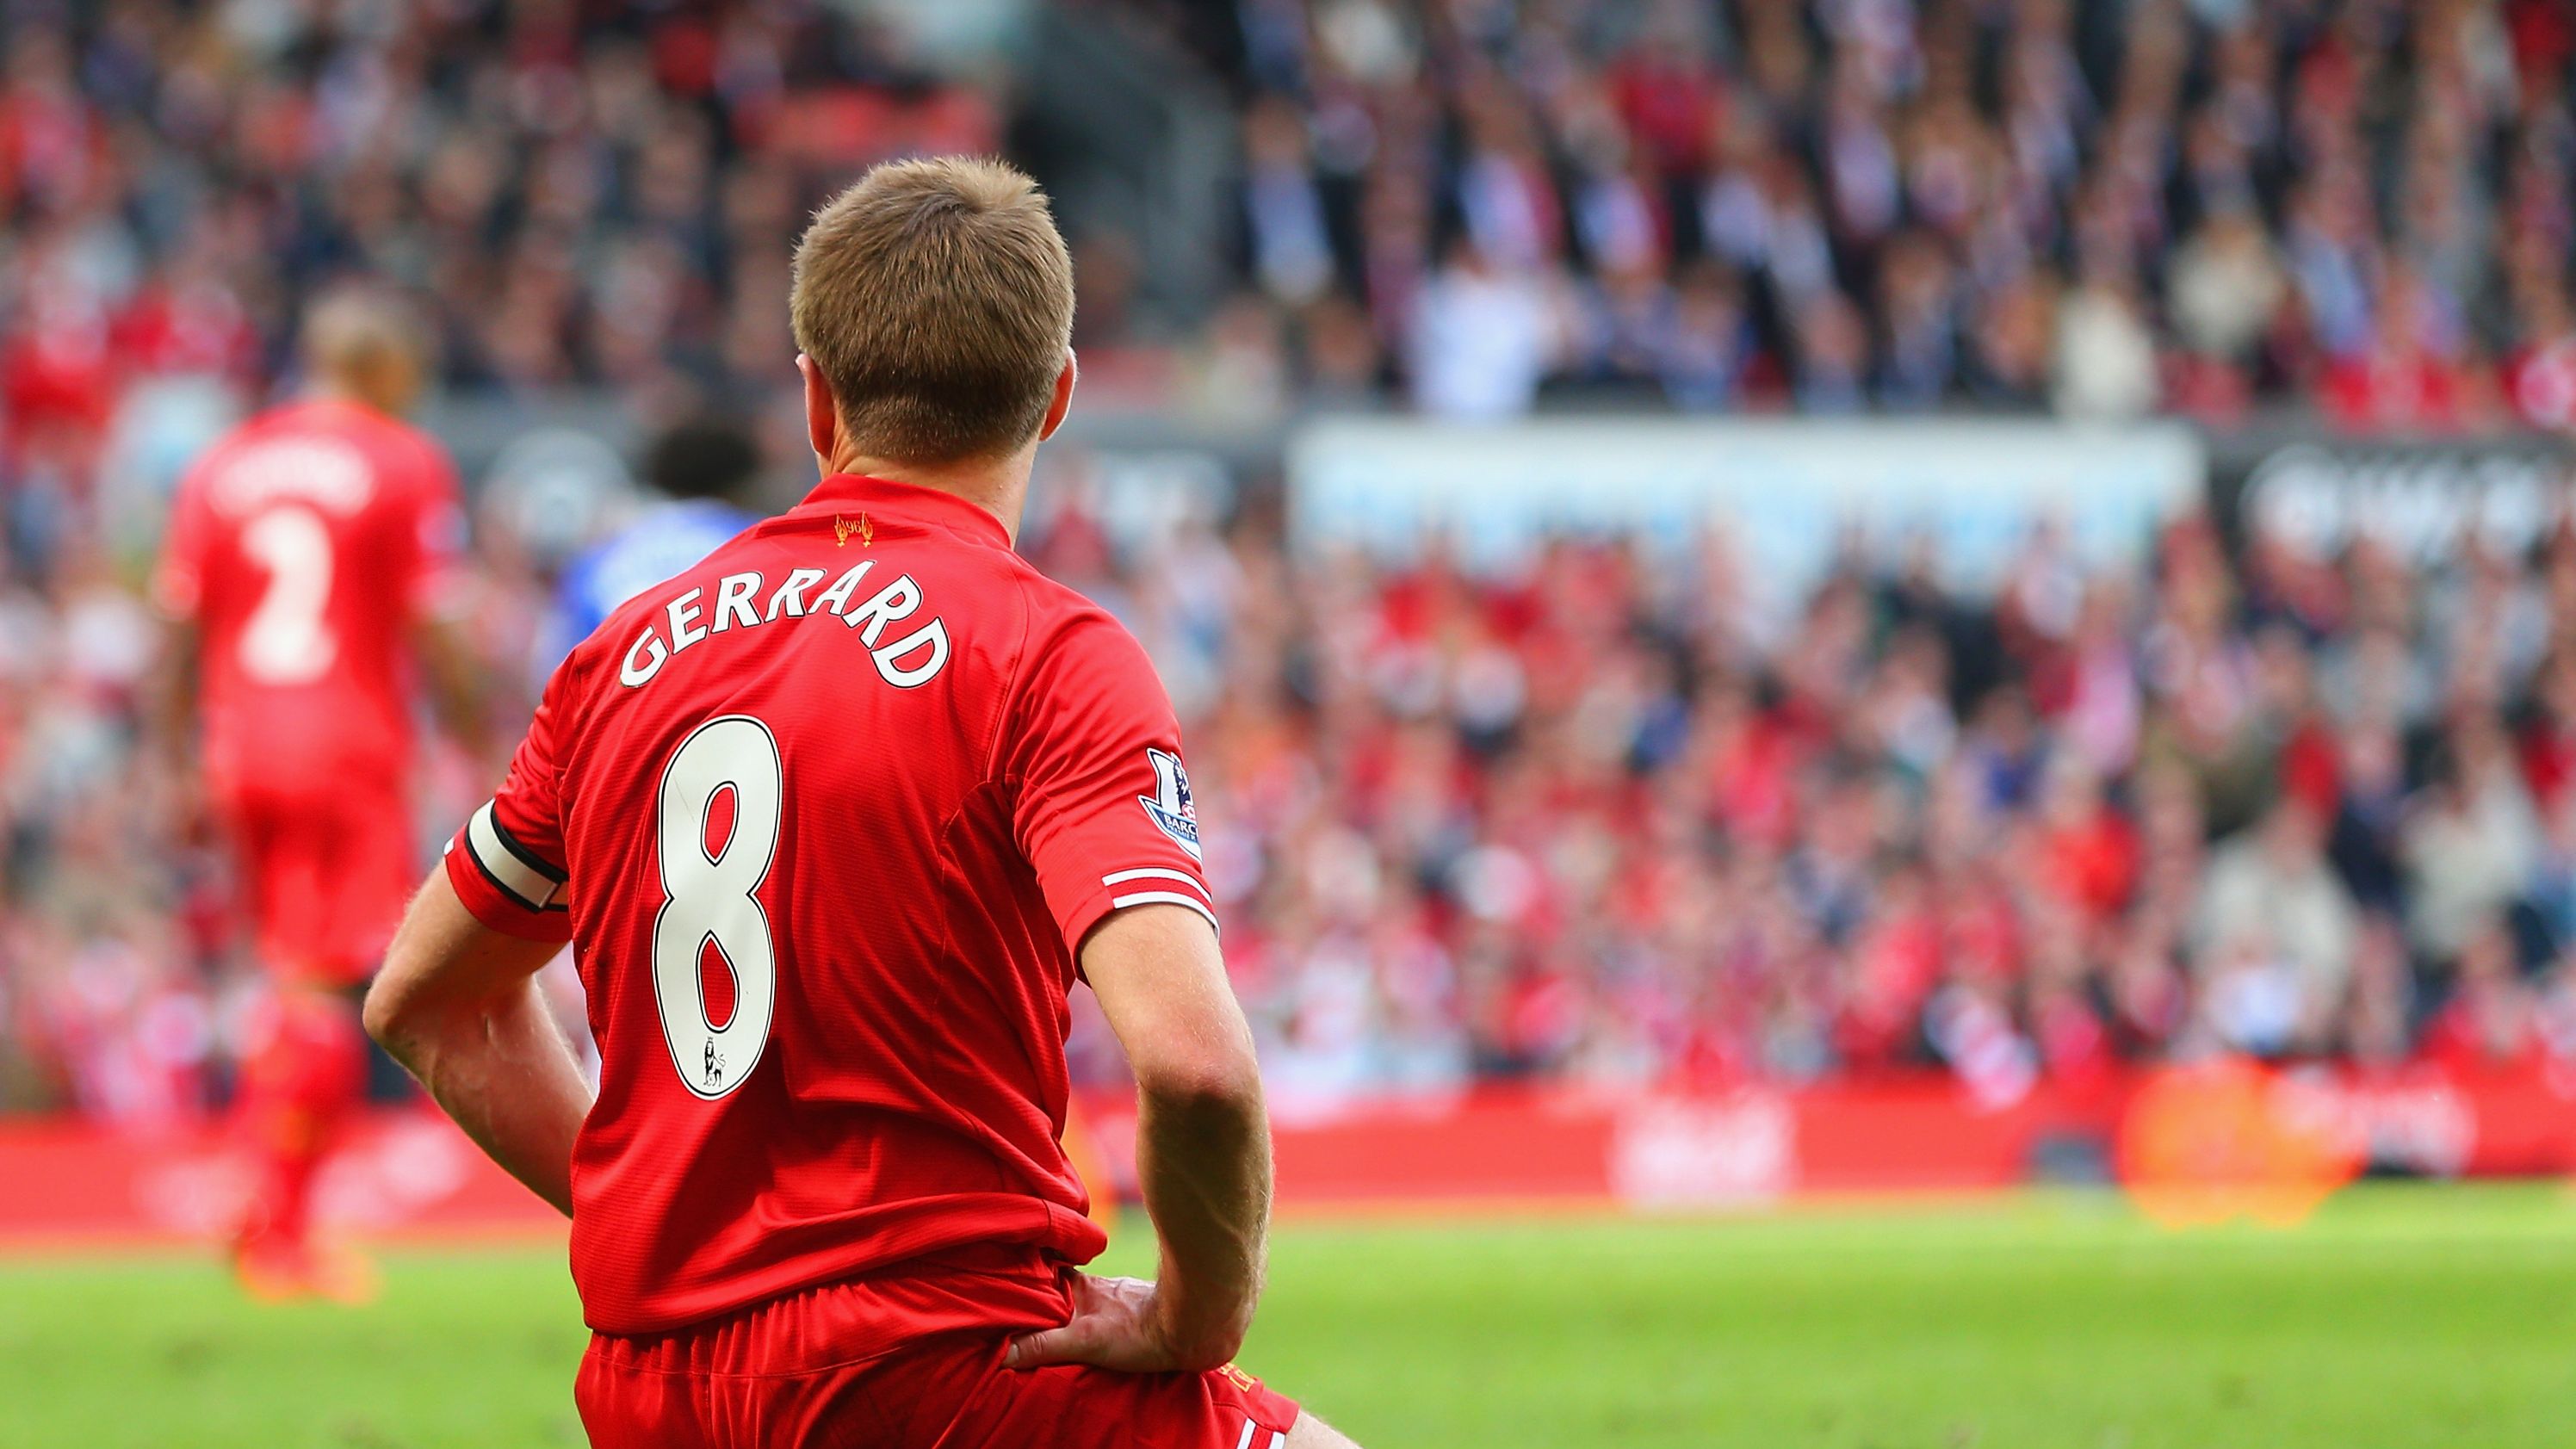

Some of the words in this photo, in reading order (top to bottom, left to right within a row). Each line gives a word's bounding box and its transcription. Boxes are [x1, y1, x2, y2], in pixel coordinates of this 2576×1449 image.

[237, 503, 338, 685] 2
[845, 521, 862, 534] 96
[620, 560, 951, 687] GERRARD
[653, 715, 783, 1101] 8
